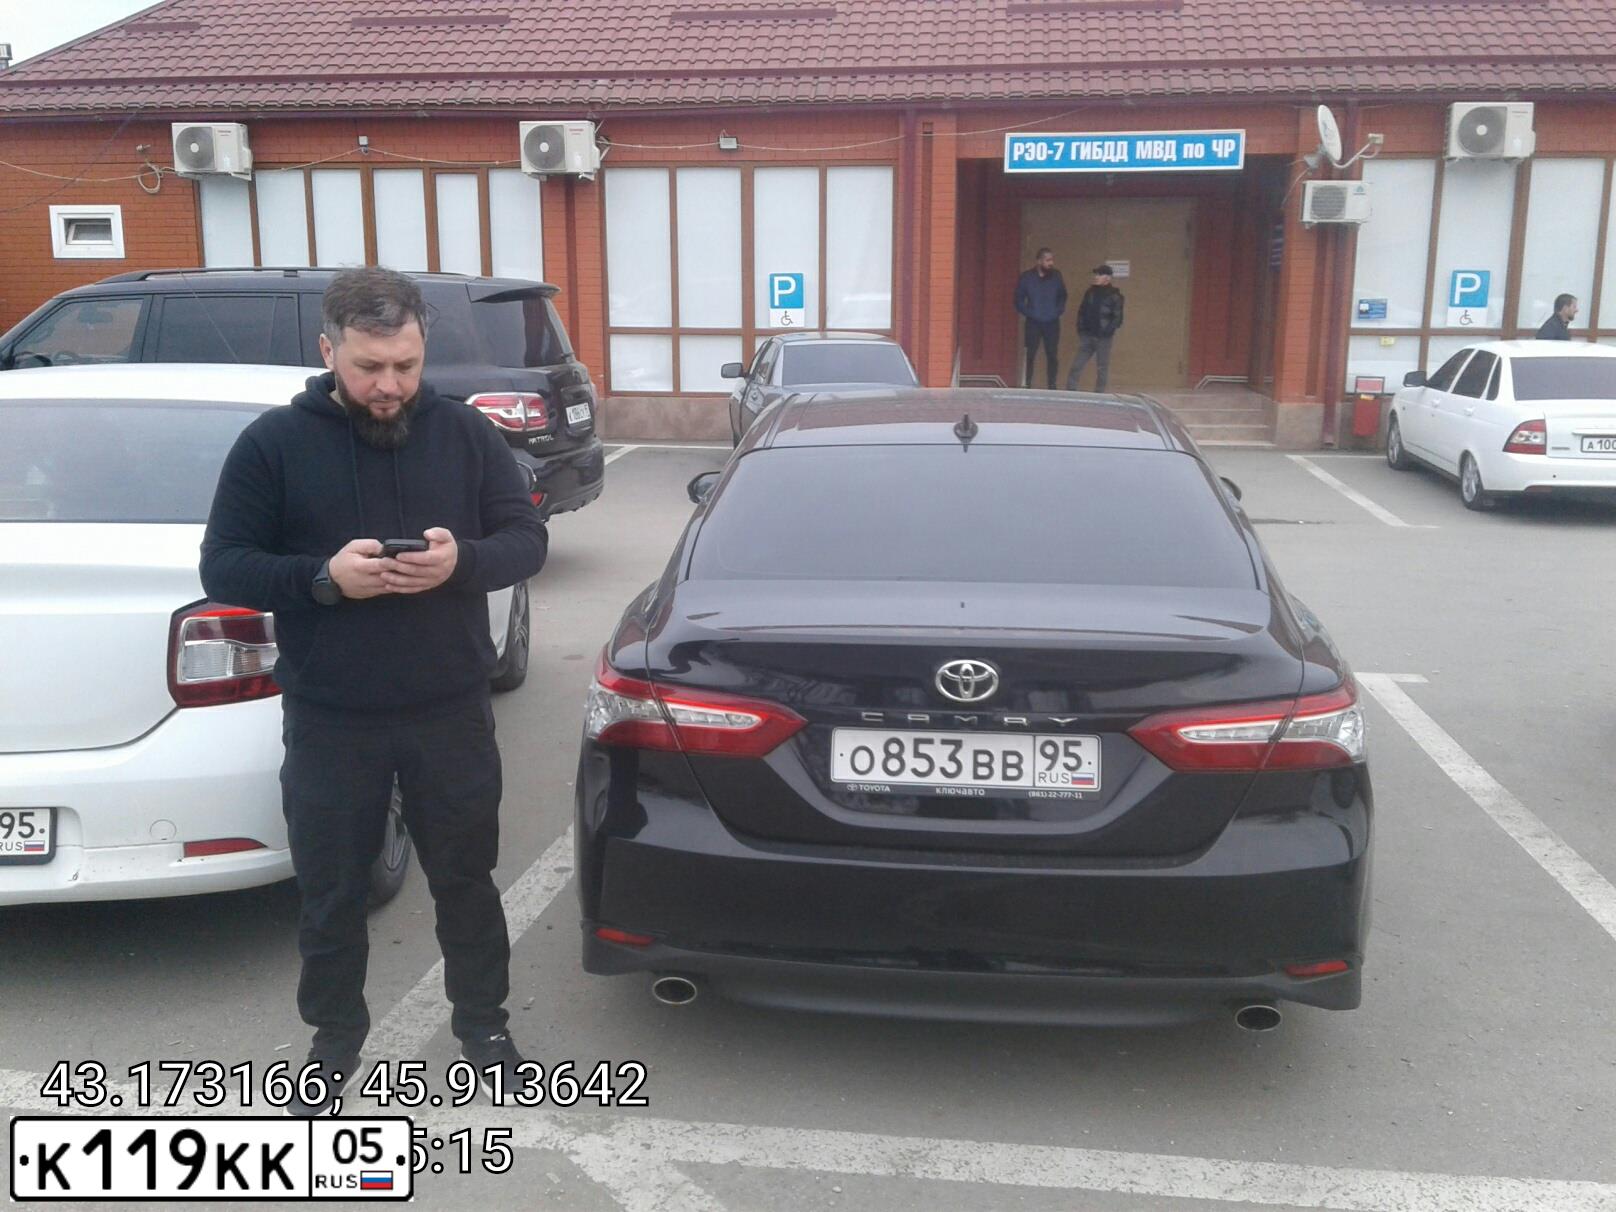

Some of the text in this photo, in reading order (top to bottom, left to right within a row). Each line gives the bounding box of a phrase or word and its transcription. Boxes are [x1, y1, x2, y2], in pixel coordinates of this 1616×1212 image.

[1012, 139, 1236, 162] РЭО-7 ГИБДД МВД по ЧР
[861, 711, 1078, 726] CAMRY
[850, 736, 1024, 782] О853ВВ
[1039, 739, 1082, 772] 95
[1038, 772, 1070, 784] RUS
[858, 784, 891, 793] TOYOTA
